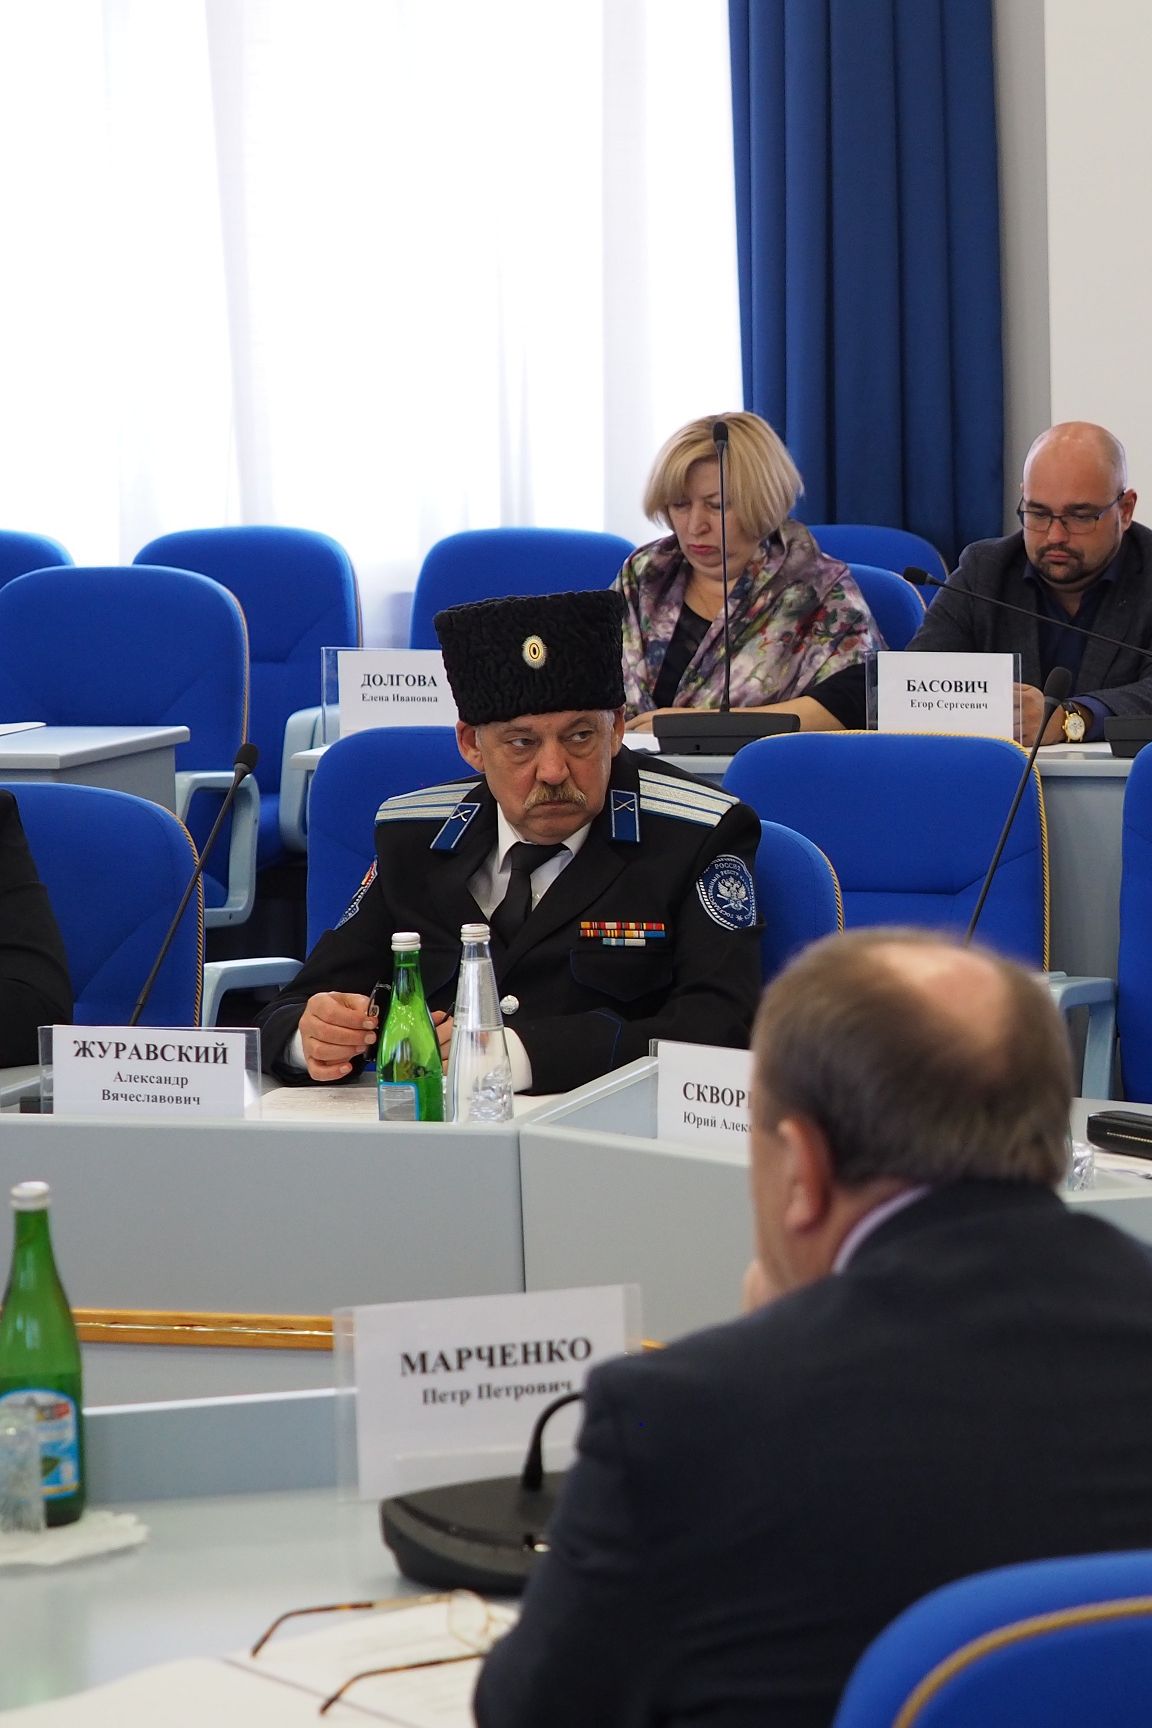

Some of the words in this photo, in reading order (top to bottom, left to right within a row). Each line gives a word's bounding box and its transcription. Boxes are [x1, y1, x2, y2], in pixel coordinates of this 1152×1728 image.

[360, 673, 438, 688] ДОЛГОВА
[906, 679, 989, 694] БАСОВИЧ
[361, 693, 389, 702] Елена
[392, 693, 438, 703] Ивановна
[910, 699, 934, 710] Егор
[936, 699, 988, 711] Сергеевич
[72, 1039, 229, 1065] ЖУРАВСКИЙ
[112, 1071, 189, 1089] Александр
[101, 1088, 201, 1106] Вячеславович
[682, 1081, 750, 1109] СКВОР
[682, 1111, 717, 1129] Юрий
[399, 1336, 593, 1378] МАРЧЕНКО
[421, 1388, 470, 1407] Петр
[476, 1380, 573, 1402] Петрович
